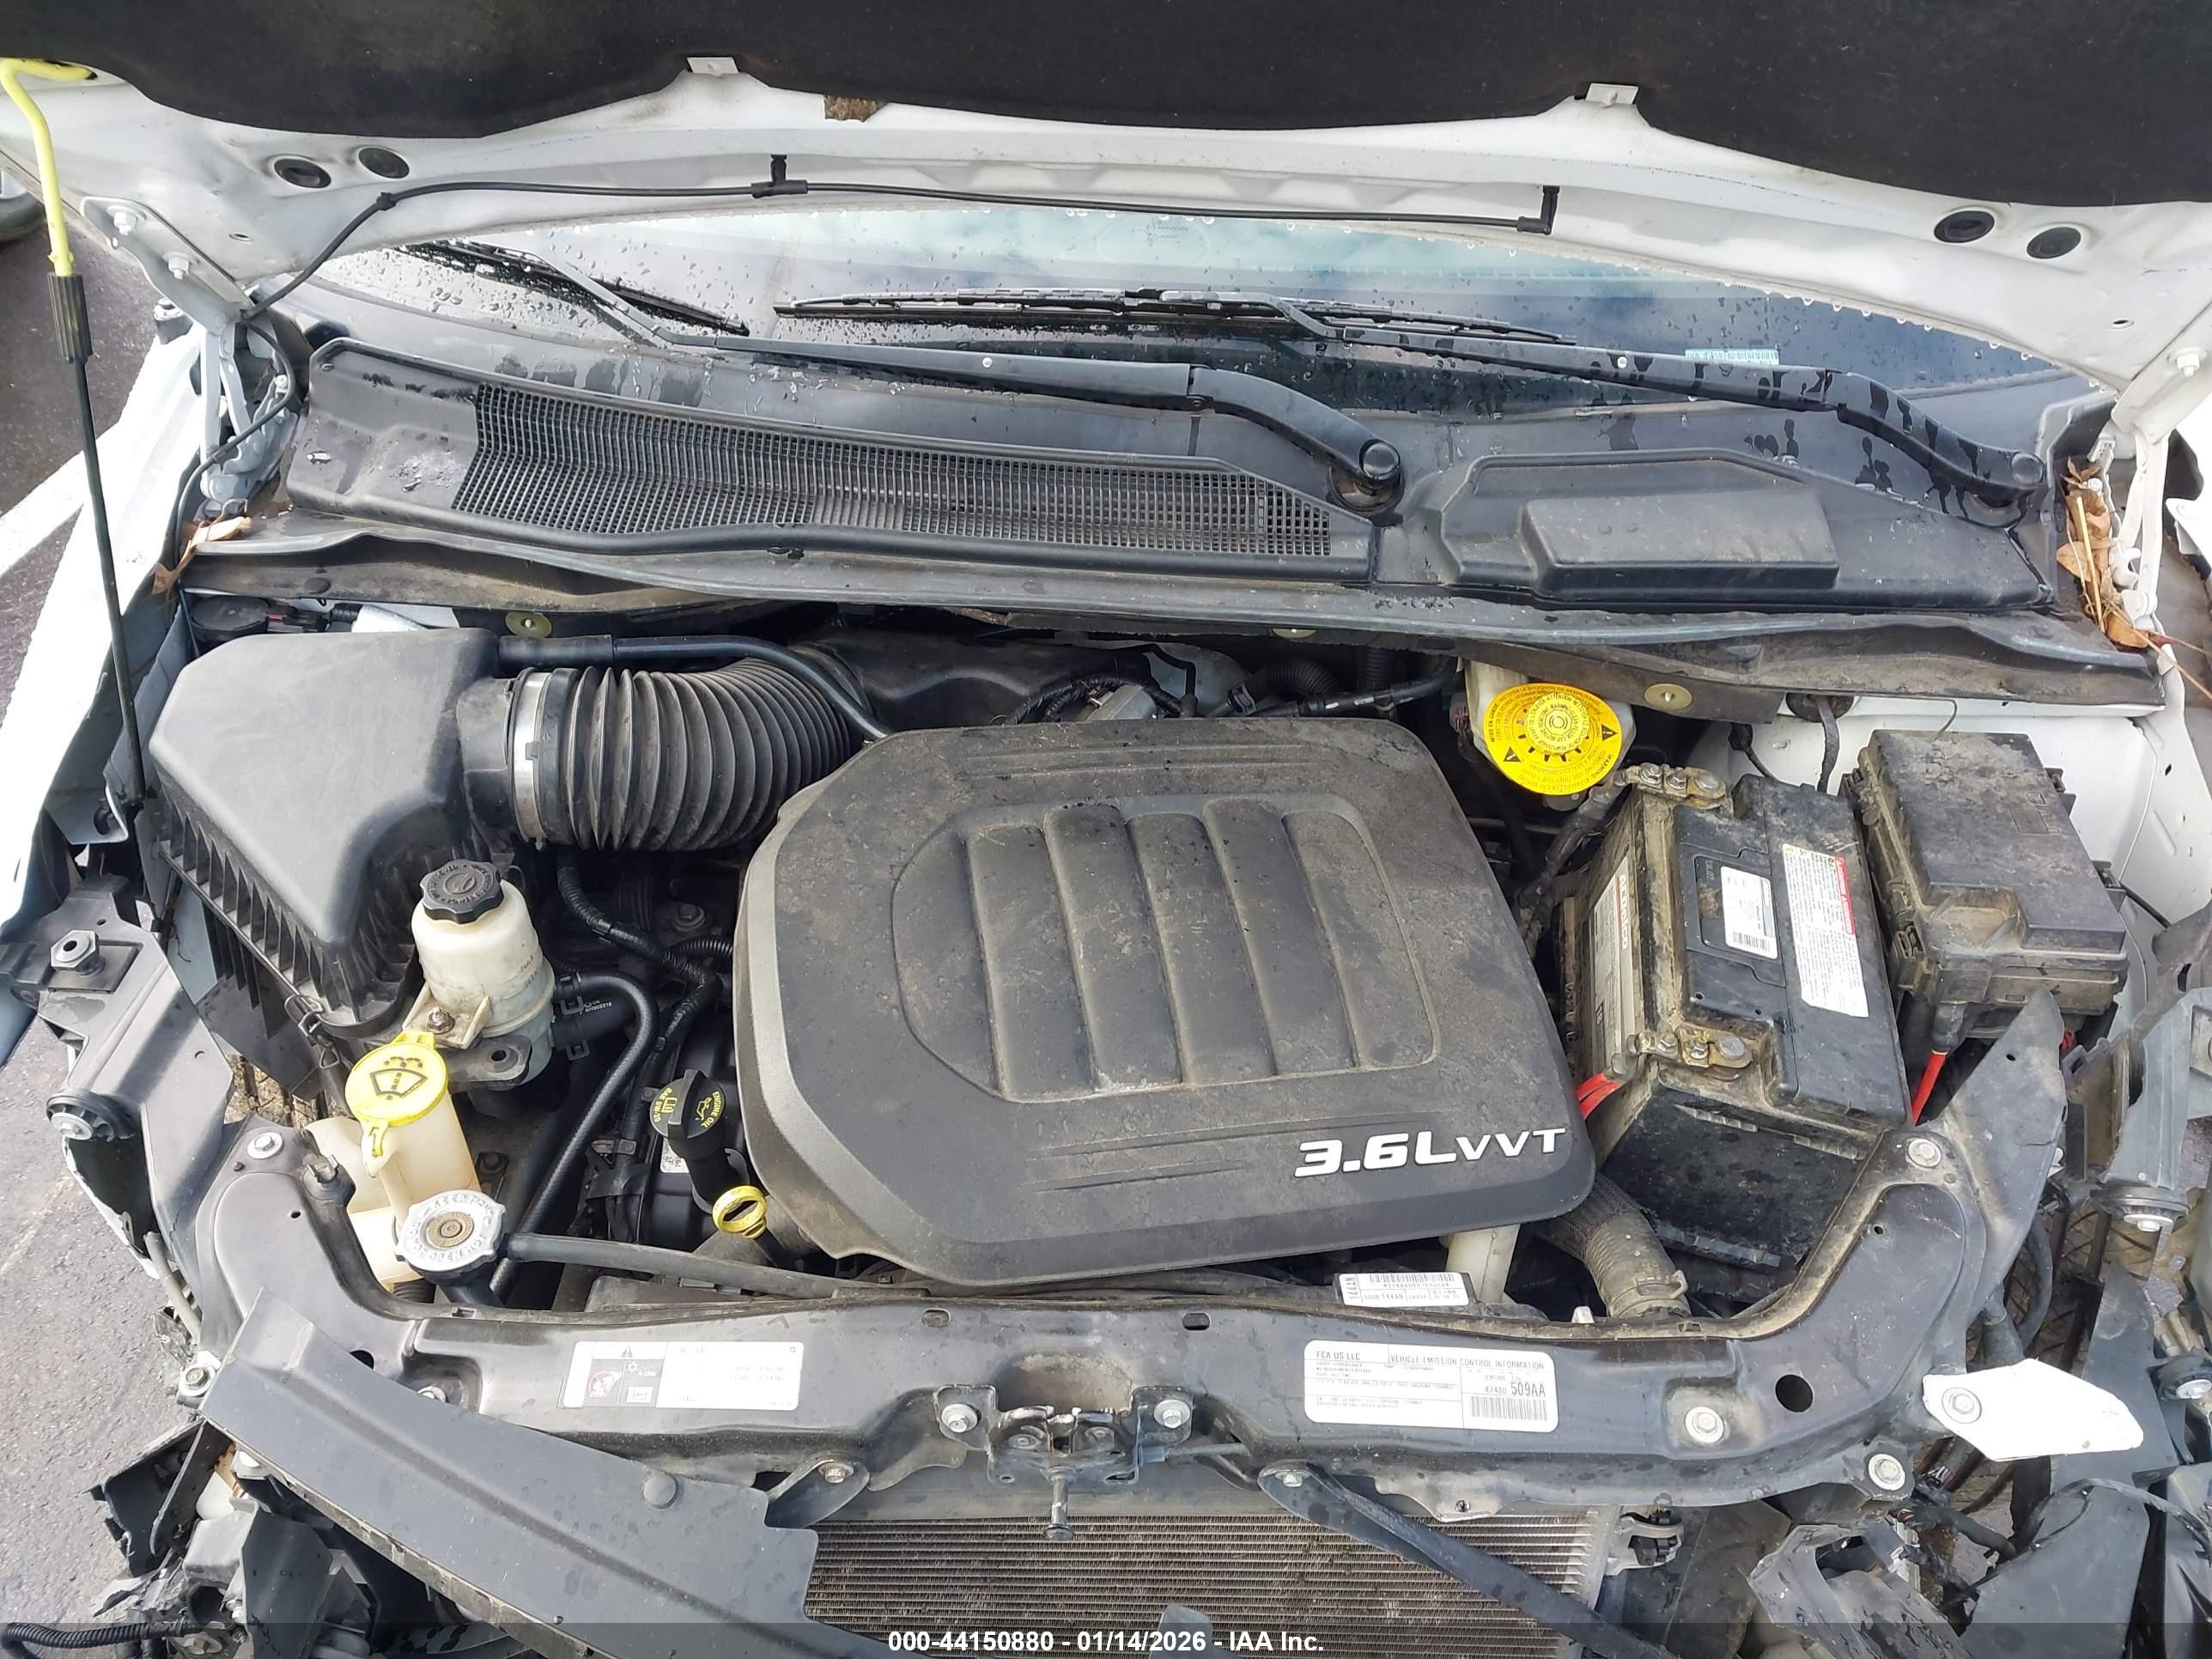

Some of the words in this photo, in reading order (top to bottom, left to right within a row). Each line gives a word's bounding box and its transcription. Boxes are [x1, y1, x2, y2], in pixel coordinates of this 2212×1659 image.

[658, 1087, 673, 1101] SAE
[711, 1091, 722, 1117] ENGINE
[700, 1116, 714, 1128] OIL
[1316, 1350, 1331, 1359] FCA
[1333, 1351, 1345, 1360] US
[1346, 1352, 1361, 1361] LLC
[1389, 1353, 1419, 1364] VEHICLE
[1422, 1356, 1457, 1366] EMISSION
[1460, 1358, 1492, 1368] CONTROL
[1495, 1359, 1545, 1370] INFORMATION
[1510, 1381, 1547, 1398] 509AA
